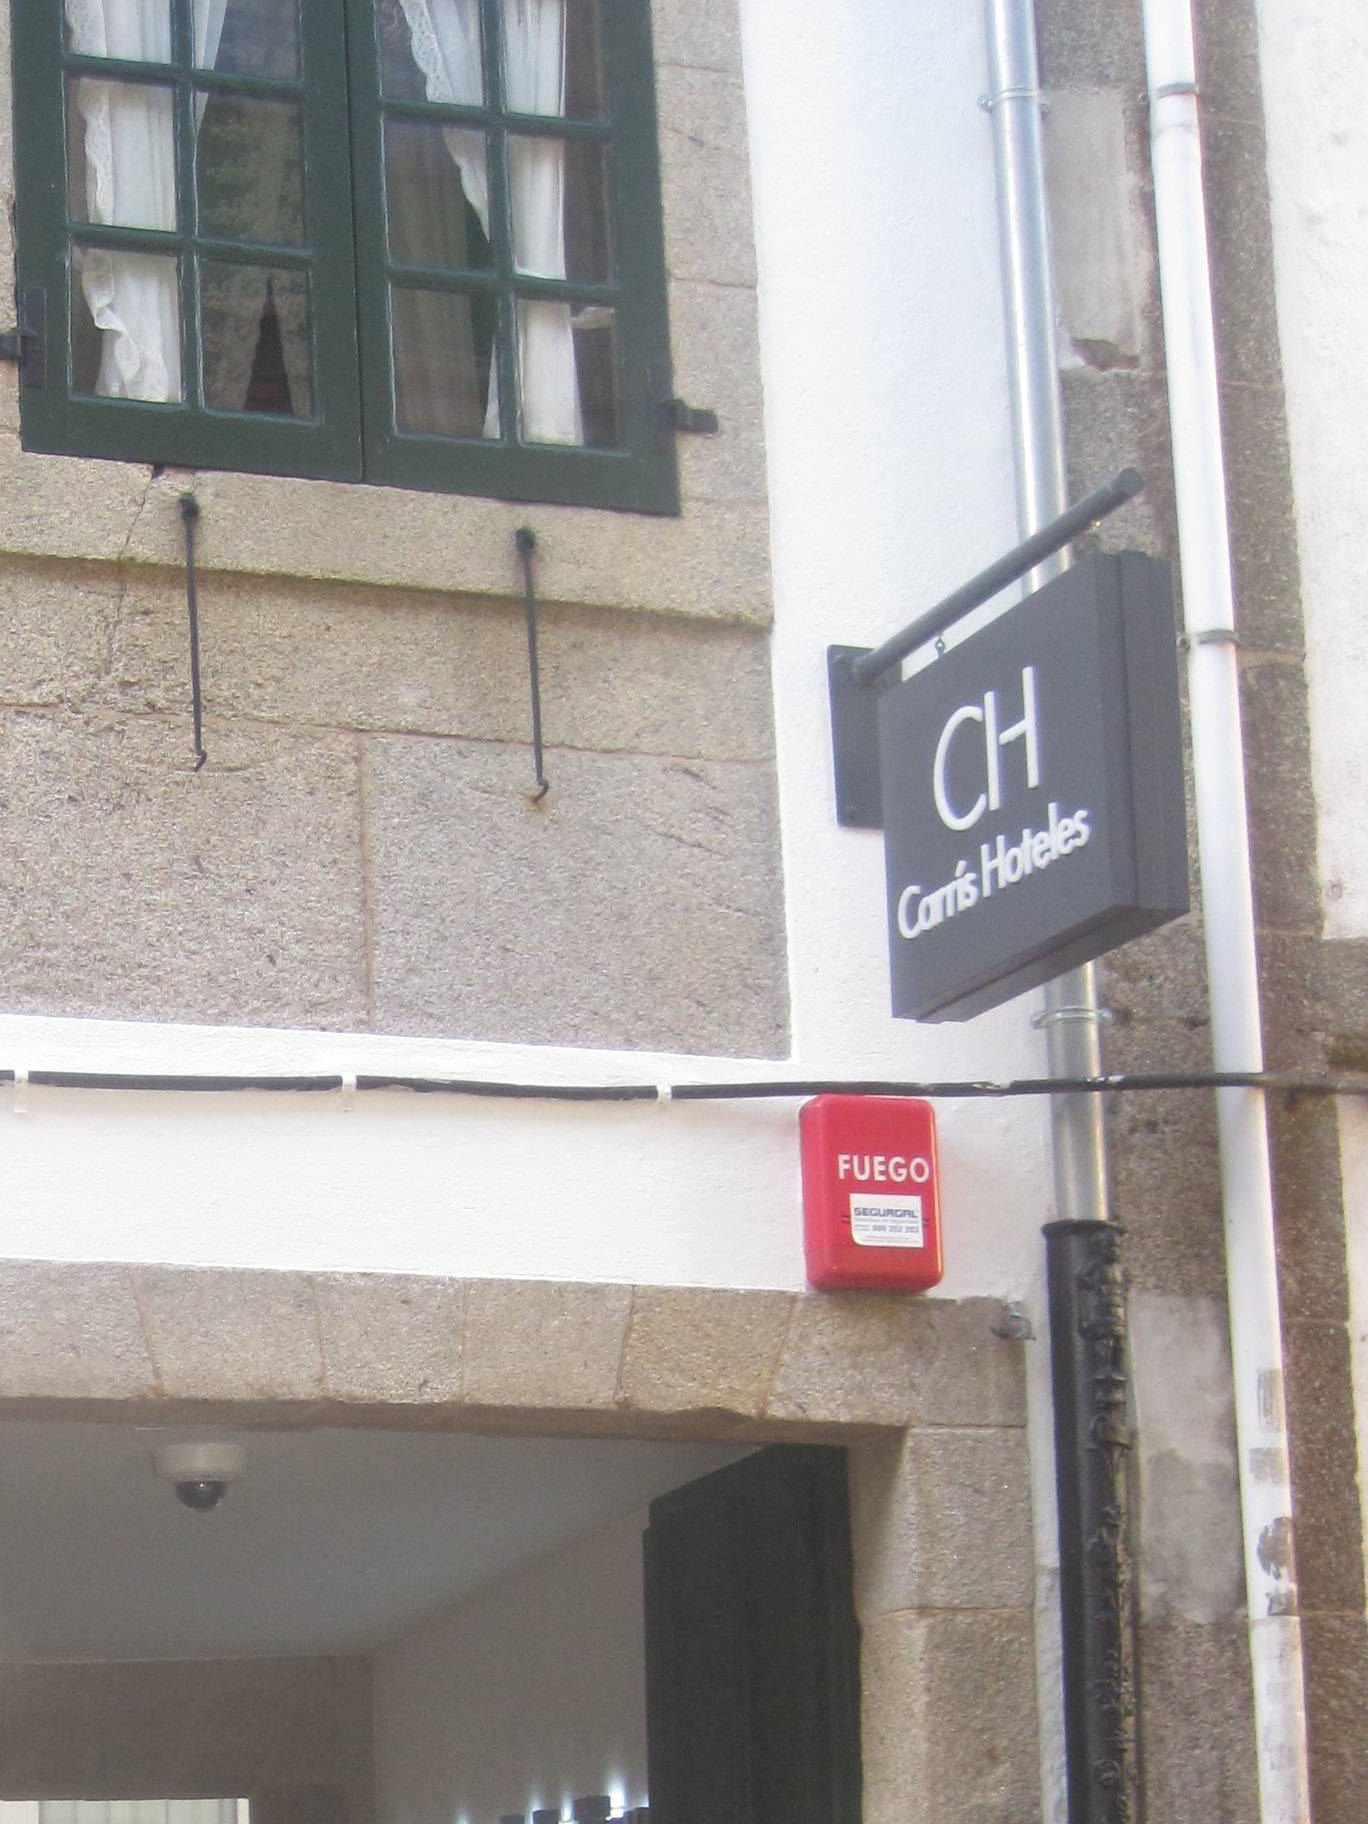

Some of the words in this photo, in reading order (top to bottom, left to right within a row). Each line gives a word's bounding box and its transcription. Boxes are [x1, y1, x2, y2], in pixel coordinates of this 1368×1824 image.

[933, 667, 1039, 831] CH
[898, 860, 978, 939] Carrís
[981, 802, 1090, 896] Hoteles
[838, 1154, 930, 1183] FUEGO
